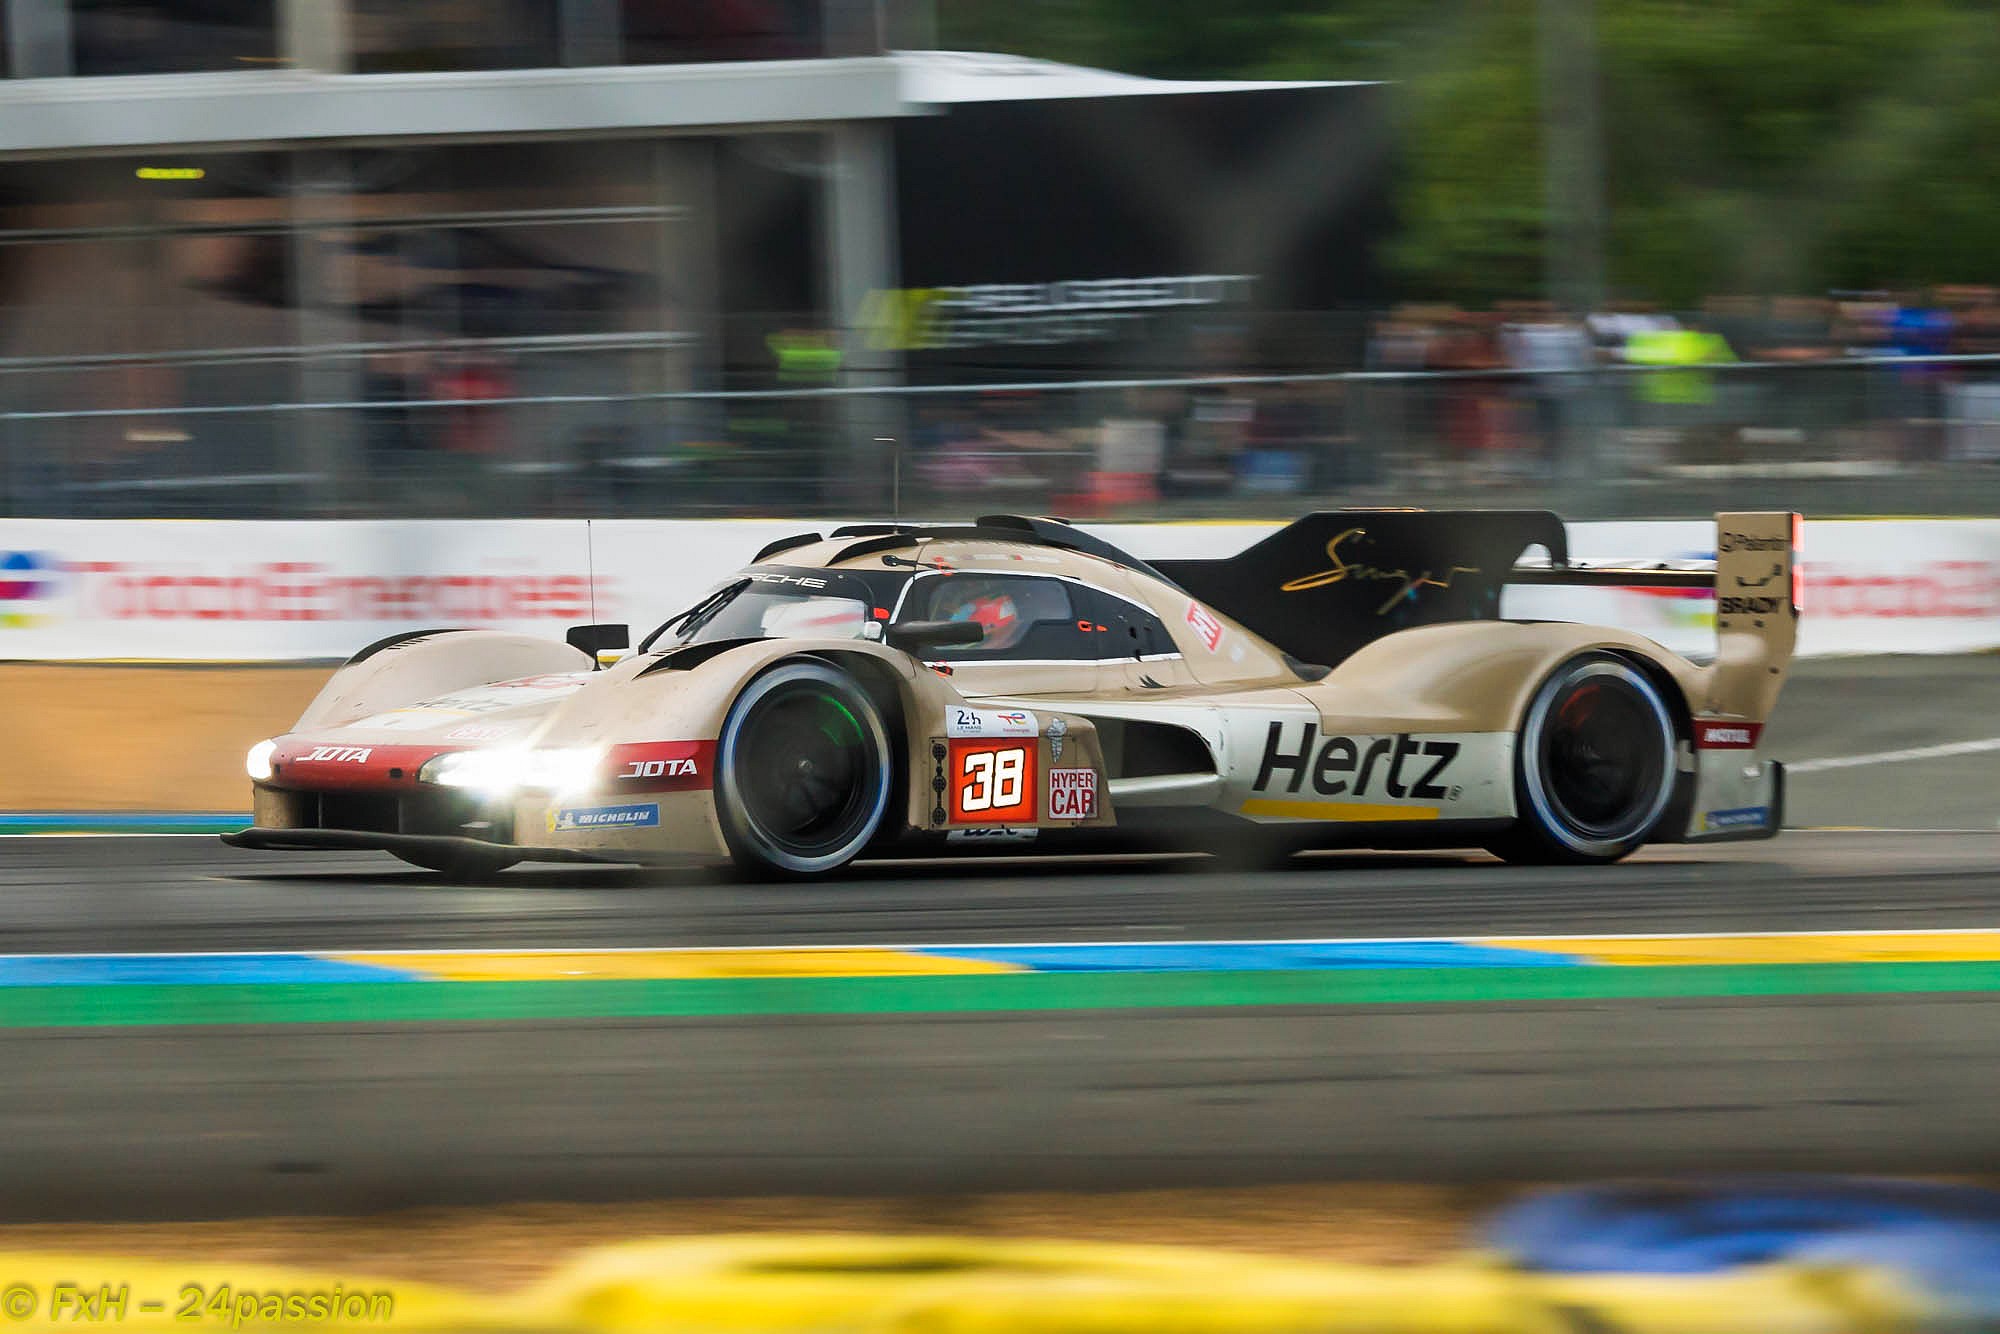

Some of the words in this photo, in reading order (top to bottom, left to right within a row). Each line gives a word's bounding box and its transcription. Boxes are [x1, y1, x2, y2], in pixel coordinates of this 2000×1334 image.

[295, 746, 373, 763] JOTA
[1252, 720, 1461, 799] Hertz
[617, 758, 698, 779] JOTA
[962, 747, 1025, 813] 38
[1051, 772, 1094, 788] HYPER
[1051, 789, 1095, 815] CAR
[579, 810, 650, 824] MICHELIN
